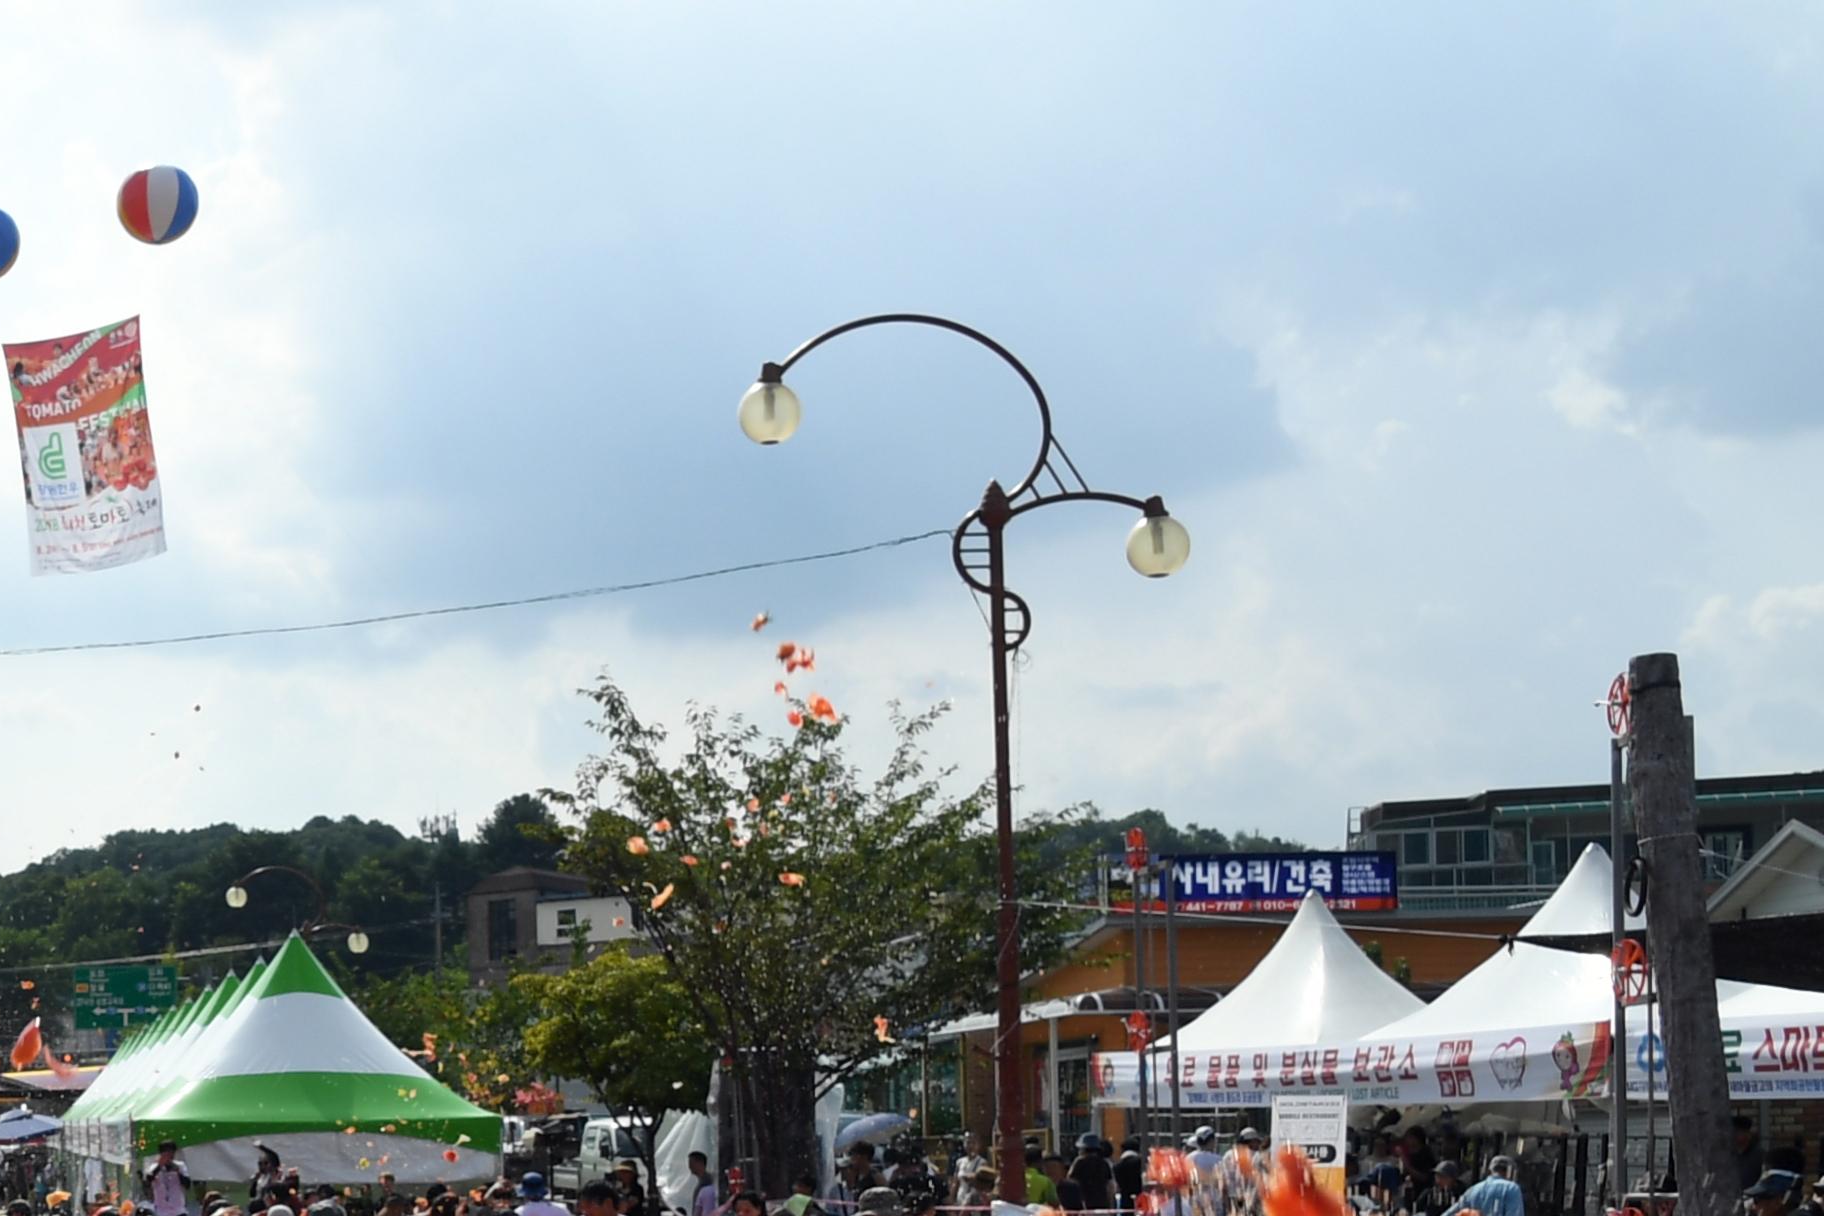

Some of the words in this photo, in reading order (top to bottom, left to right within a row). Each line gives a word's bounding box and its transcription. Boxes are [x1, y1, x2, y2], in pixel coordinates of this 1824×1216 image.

[25, 398, 82, 421] TOMATO
[87, 506, 130, 530] 토마토
[1206, 1054, 1241, 1089] 물품
[1251, 1052, 1268, 1088] 및
[1280, 1048, 1339, 1086] 분실물
[1352, 1043, 1419, 1083] 보관소
[1370, 1085, 1400, 1100] ARTICLE
